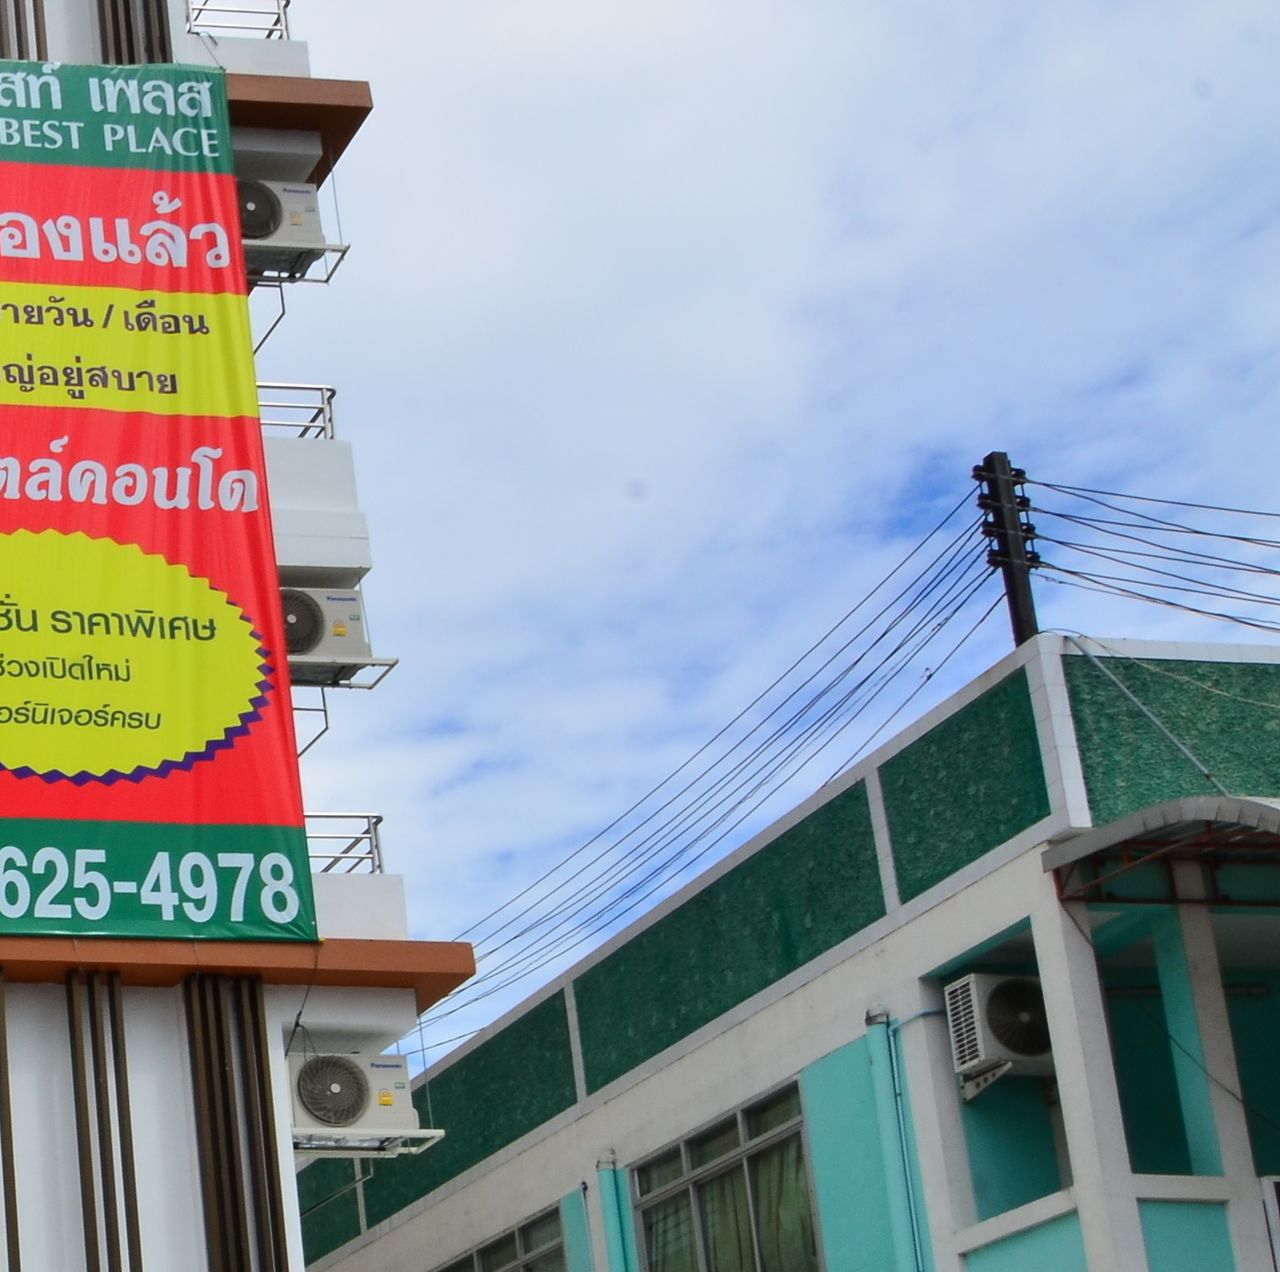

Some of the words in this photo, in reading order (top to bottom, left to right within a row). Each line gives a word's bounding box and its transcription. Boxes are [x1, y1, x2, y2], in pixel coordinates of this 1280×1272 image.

[89, 75, 213, 118] เพลส
[104, 124, 220, 158] PLACE
[123, 300, 210, 335] เดือน
[50, 607, 217, 641] ราคาพิเศษ
